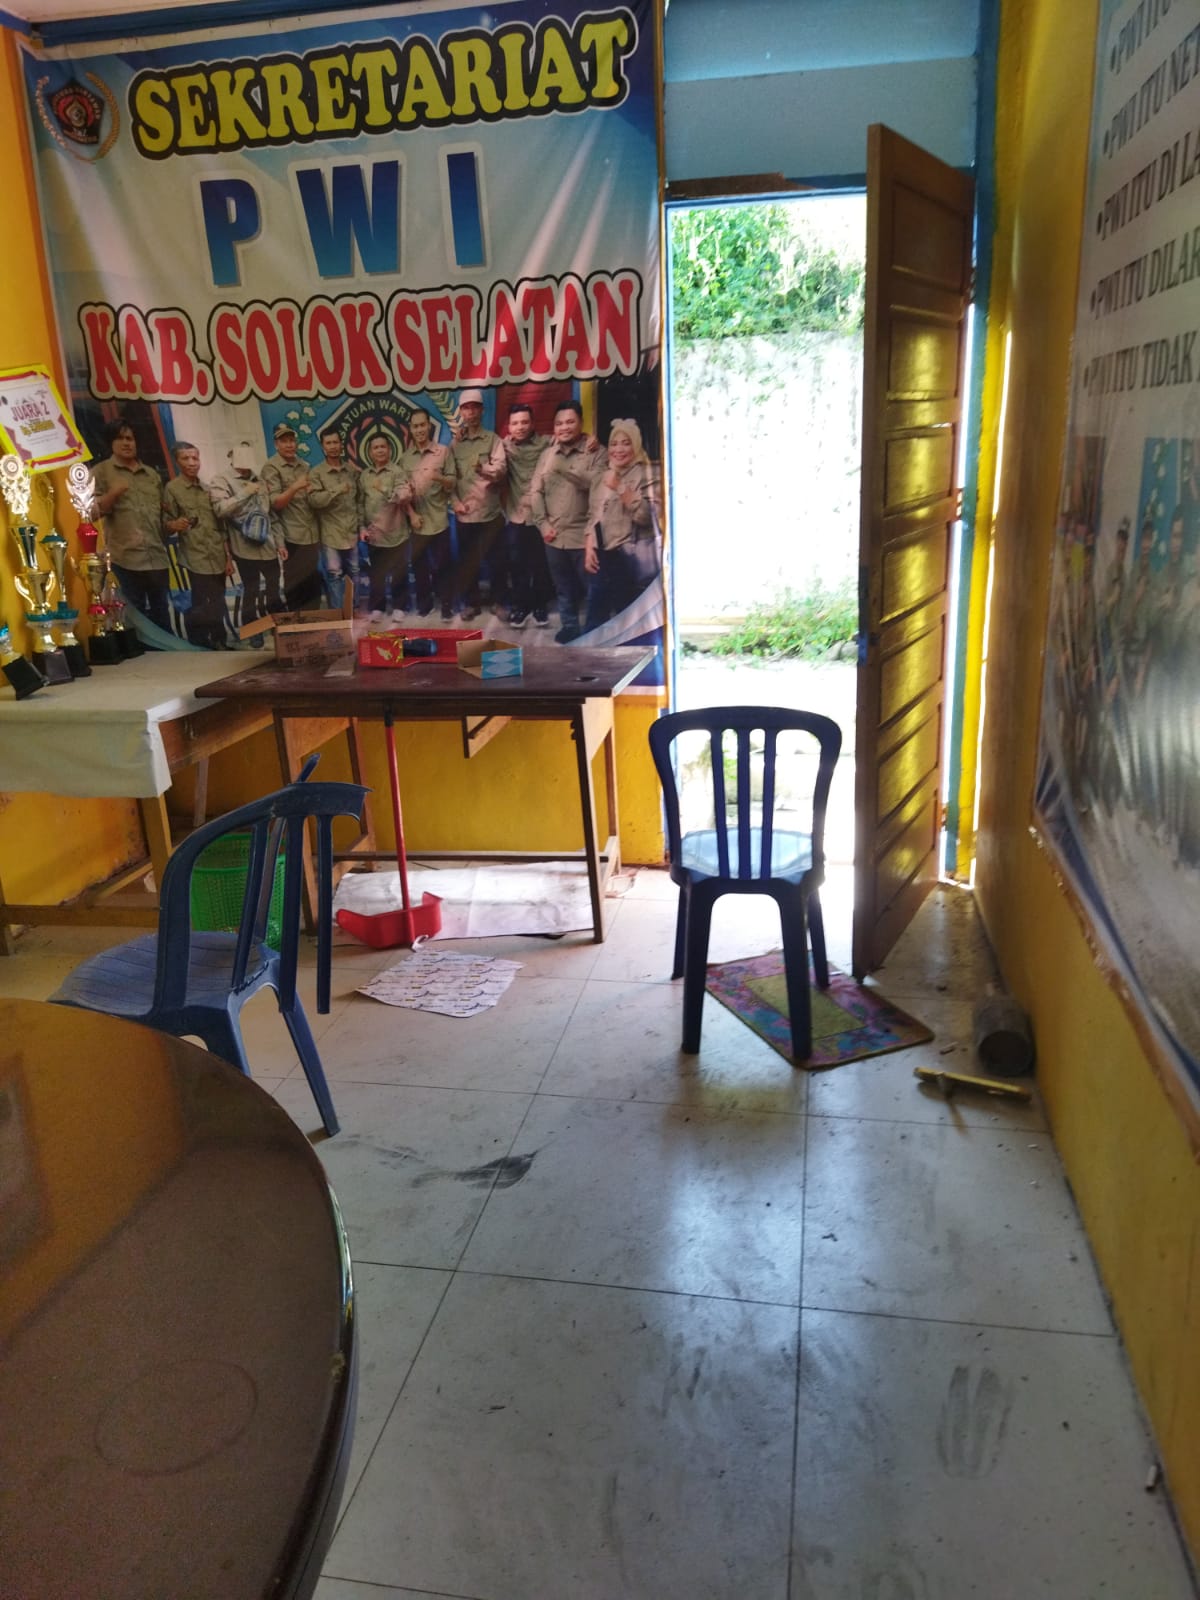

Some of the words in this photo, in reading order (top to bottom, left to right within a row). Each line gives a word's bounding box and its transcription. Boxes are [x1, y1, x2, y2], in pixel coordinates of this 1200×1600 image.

[132, 17, 630, 154] SEKRETARIAT
[1109, 92, 1137, 160] PWI
[1137, 60, 1167, 132] ITU
[1101, 182, 1129, 241] PWI
[1128, 159, 1158, 222] ITU
[1157, 140, 1180, 202] DI
[1095, 268, 1122, 320] PWI
[1120, 254, 1149, 309] ITU
[85, 311, 209, 397] KAB.
[215, 301, 387, 395] SOLOK
[393, 279, 634, 387] SELATAN
[1112, 346, 1140, 393] ITU
[1141, 331, 1197, 389] TIDAK
[11, 403, 43, 421] JUARA
[40, 401, 49, 415] 2
